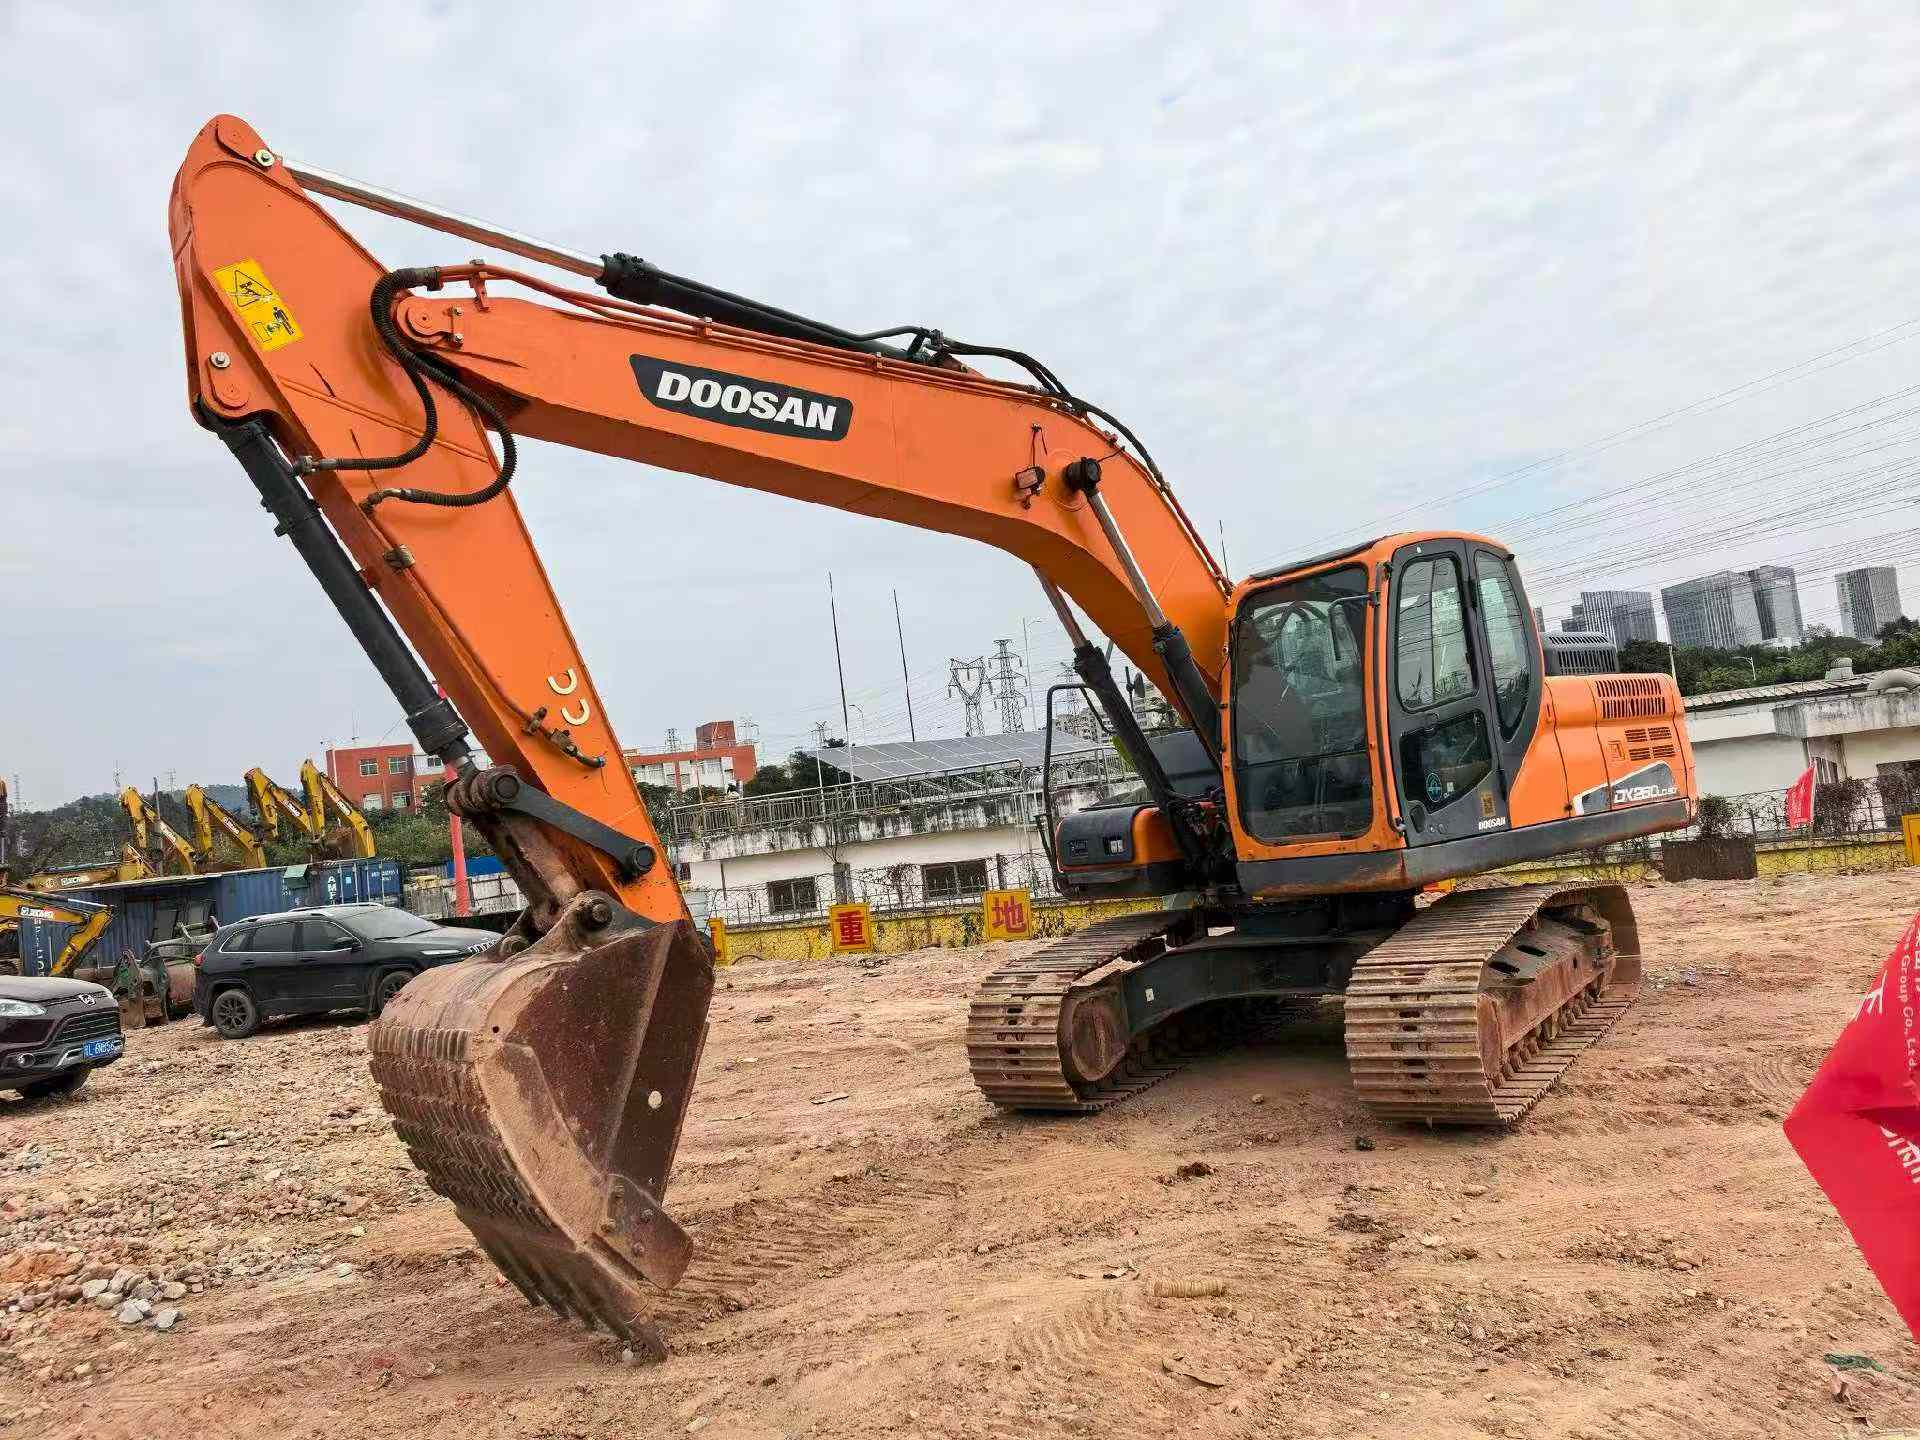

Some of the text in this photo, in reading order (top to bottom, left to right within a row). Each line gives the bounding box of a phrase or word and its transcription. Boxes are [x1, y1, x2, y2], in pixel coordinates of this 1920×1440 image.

[655, 370, 837, 432] DOOSAN
[836, 910, 864, 945] 重
[991, 895, 1027, 933] 地
[1899, 954, 1911, 1004] Group
[1905, 1037, 1919, 1071] Ltd.
